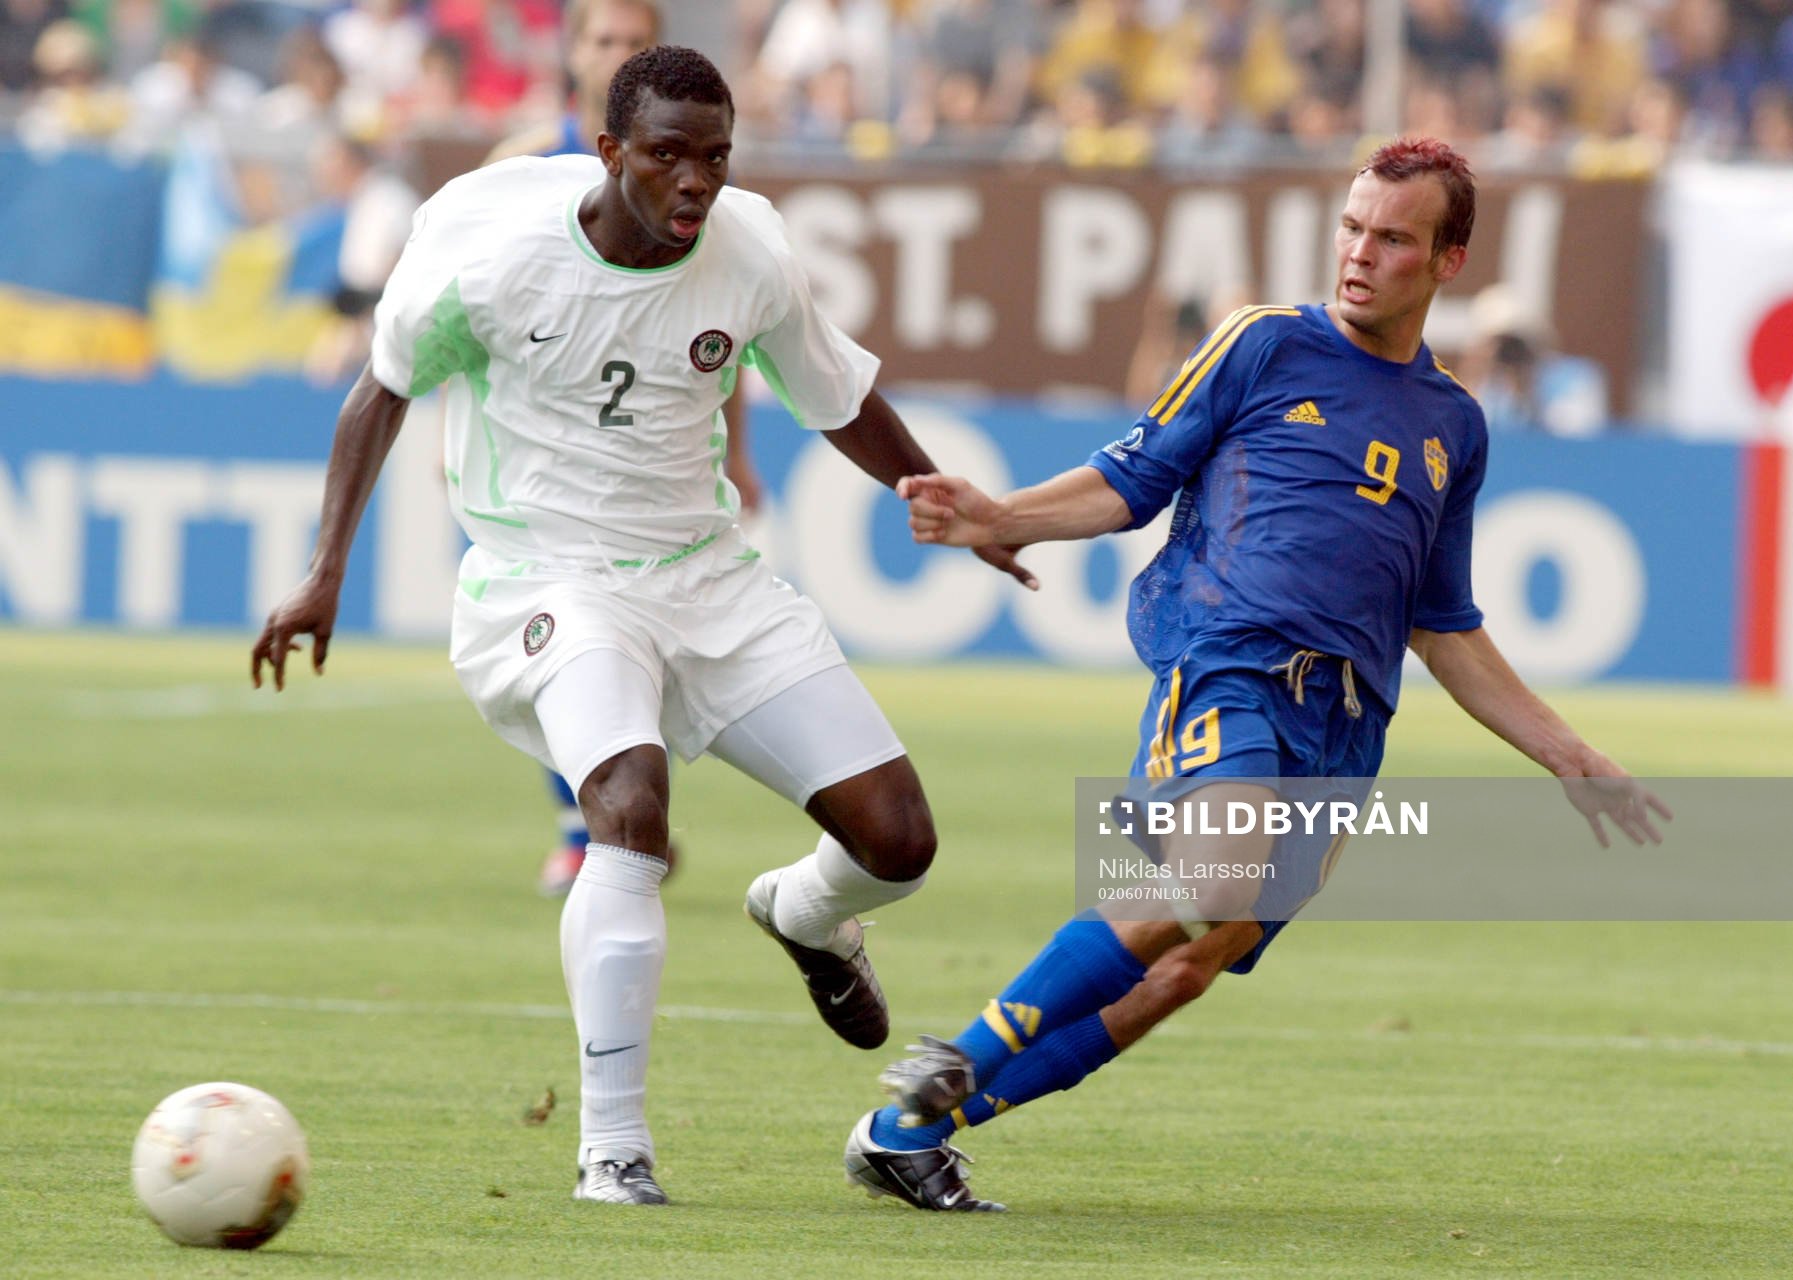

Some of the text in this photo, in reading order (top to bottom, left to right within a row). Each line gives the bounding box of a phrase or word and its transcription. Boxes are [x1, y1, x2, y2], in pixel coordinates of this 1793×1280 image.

[780, 183, 1564, 352] ST. PAUI
[599, 360, 635, 427] 2
[1283, 413, 1327, 426] adidas
[1355, 439, 1400, 506] 9
[0, 452, 335, 632] NTT
[1180, 706, 1221, 771] 9
